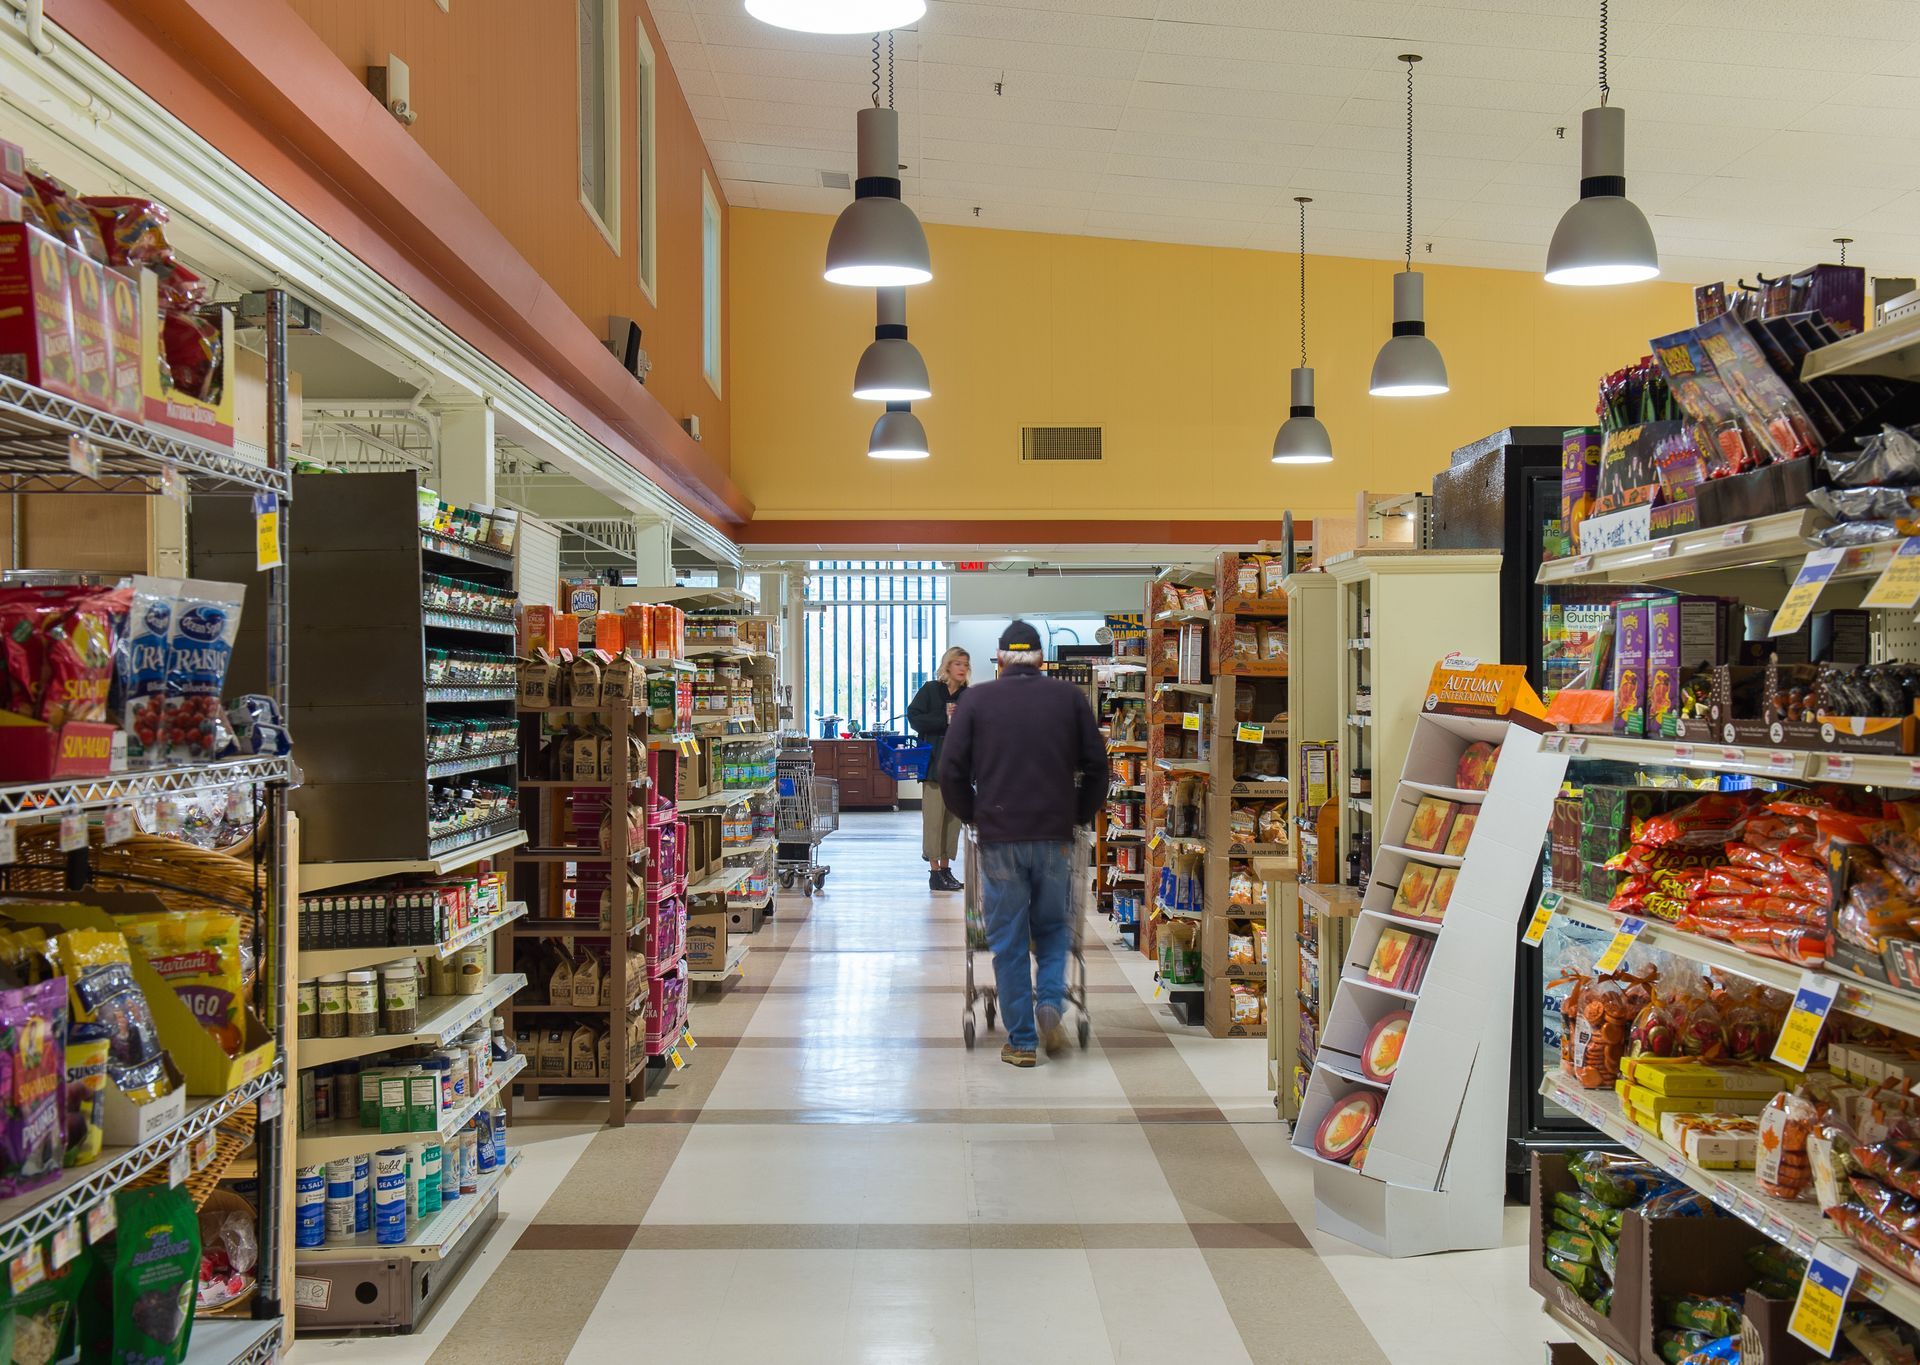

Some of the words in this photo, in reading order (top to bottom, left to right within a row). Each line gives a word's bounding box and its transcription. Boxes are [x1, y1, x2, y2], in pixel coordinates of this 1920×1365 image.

[574, 591, 595, 603] Mini
[573, 601, 595, 612] Wheats
[1567, 611, 1611, 624] Outshin
[132, 644, 165, 674] CRA
[1444, 675, 1503, 693] AUTUMN
[1440, 690, 1498, 703] ENTERTAINING
[62, 735, 111, 758] SUN-MAID
[308, 1180, 323, 1190] SALT
[378, 1181, 393, 1189] SEA
